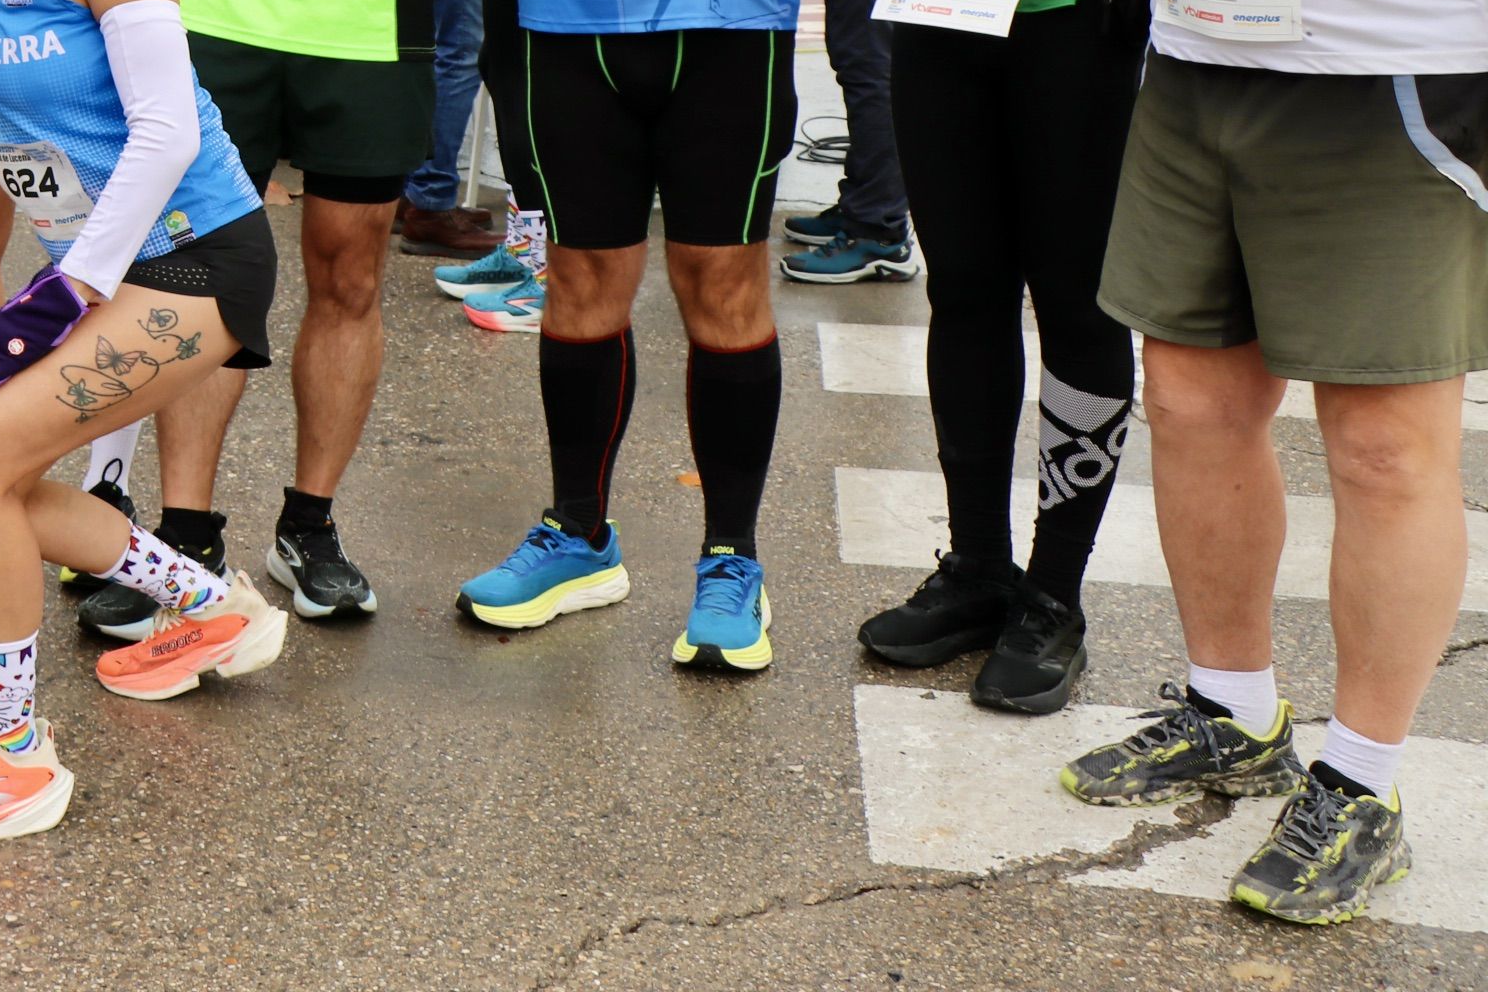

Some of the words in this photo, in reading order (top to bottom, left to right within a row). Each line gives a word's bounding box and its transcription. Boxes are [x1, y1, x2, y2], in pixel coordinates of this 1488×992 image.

[1233, 13, 1281, 24] enerplus
[2, 166, 60, 198] 624
[543, 516, 562, 531] HOKA
[710, 545, 735, 556] HOKA
[151, 628, 204, 658] BROOKS
